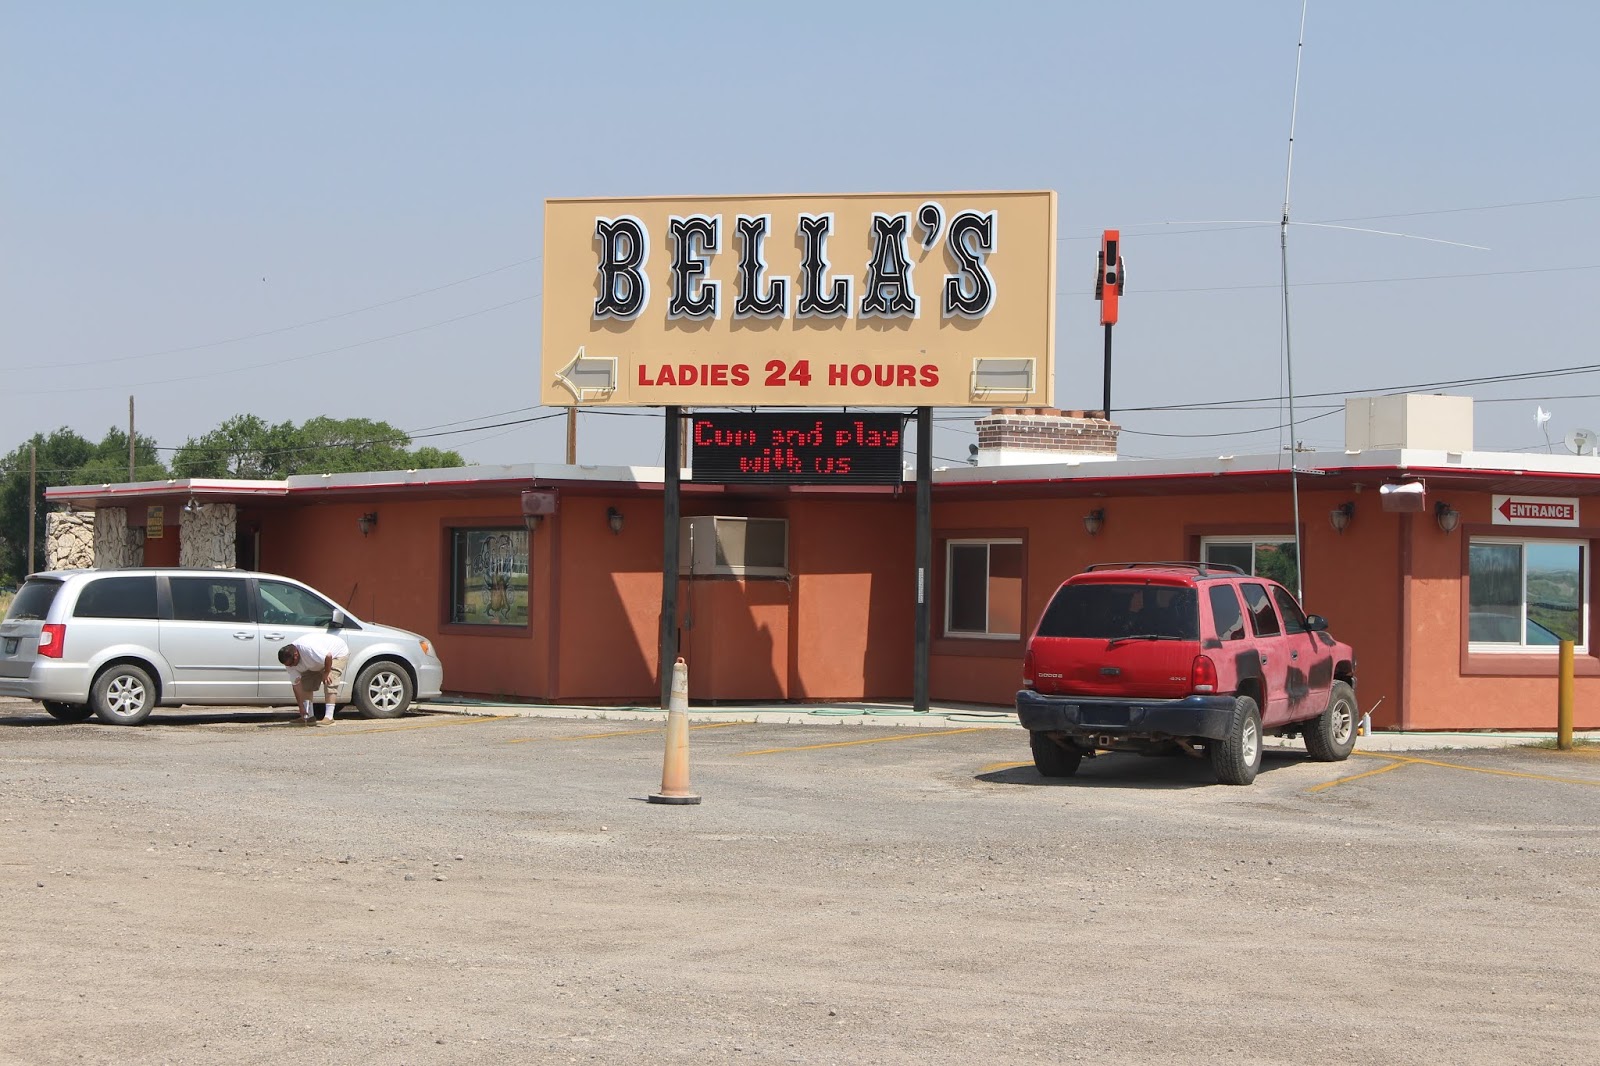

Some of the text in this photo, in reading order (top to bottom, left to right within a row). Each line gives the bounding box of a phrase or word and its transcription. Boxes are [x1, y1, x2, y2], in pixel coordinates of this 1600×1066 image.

[594, 201, 998, 321] BELLA'S
[638, 360, 940, 387] LADIES 24 HOURS
[695, 421, 899, 446] Cum and play
[739, 448, 851, 473] with us
[1510, 504, 1571, 518] ENTRANCE
